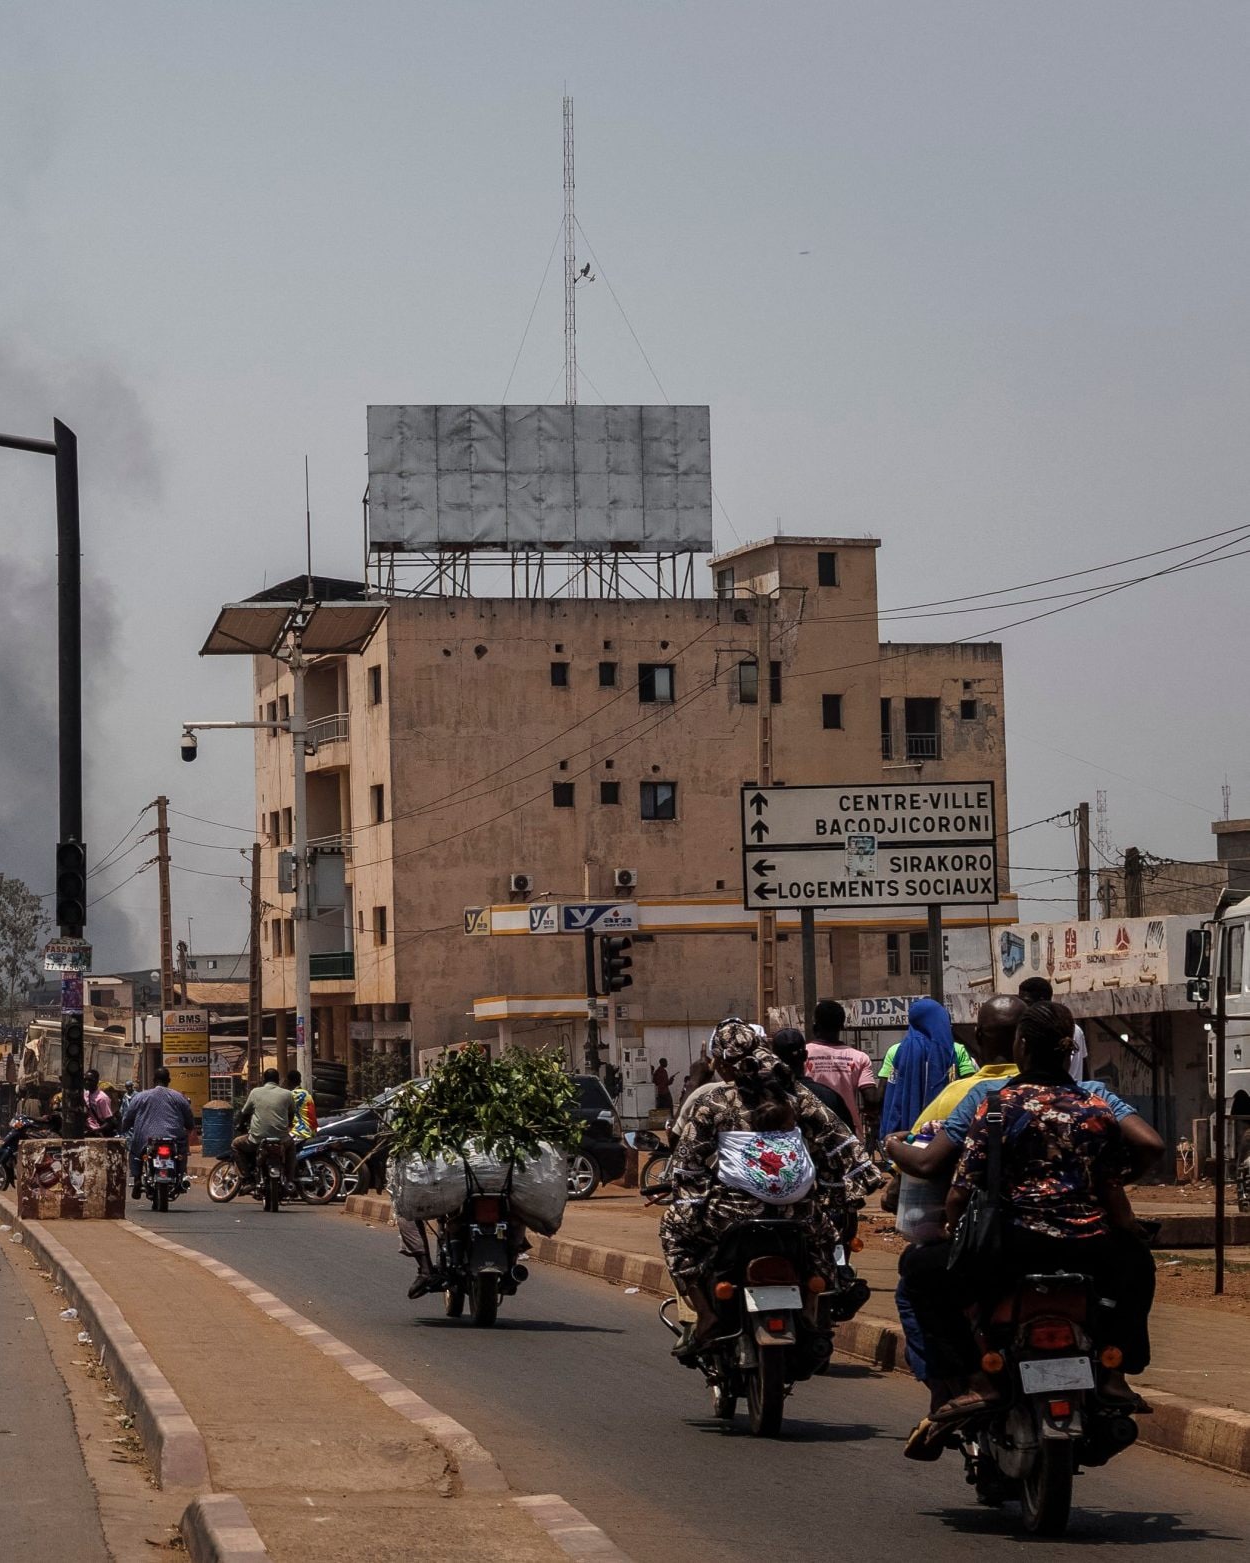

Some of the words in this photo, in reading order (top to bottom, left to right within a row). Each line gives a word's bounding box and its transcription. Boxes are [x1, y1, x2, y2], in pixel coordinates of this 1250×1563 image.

[839, 791, 989, 811] CENTRE-VILLE
[815, 815, 990, 836] BACODJICORONI
[889, 854, 992, 873] SIRAKORO
[777, 879, 900, 899] LOGEMENTS
[905, 877, 993, 896] SOCIAUX
[179, 1015, 200, 1023] BMS
[861, 1016, 884, 1026] AUTO
